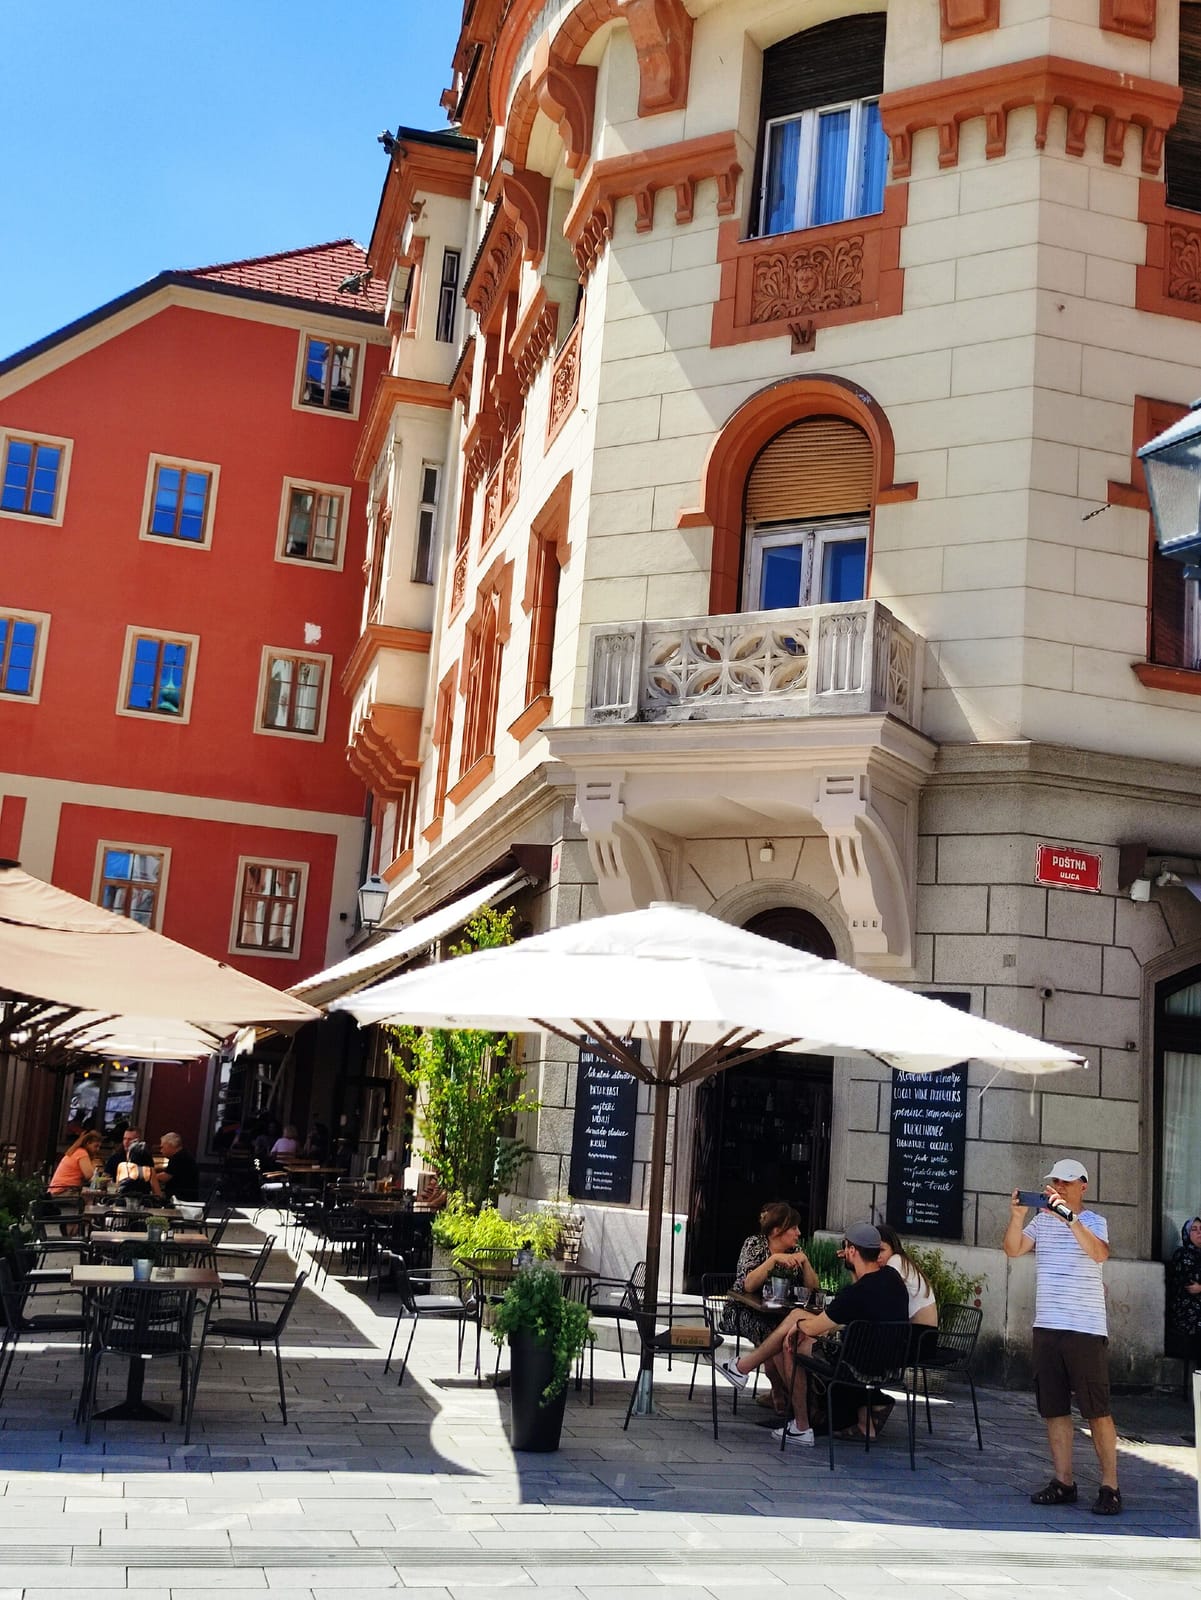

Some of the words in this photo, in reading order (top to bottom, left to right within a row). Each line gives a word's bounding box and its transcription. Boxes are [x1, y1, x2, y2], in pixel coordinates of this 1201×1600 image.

[1052, 856, 1087, 872] POŠTNA
[1059, 872, 1080, 881] ULICA
[893, 1087, 912, 1100] LOCAL
